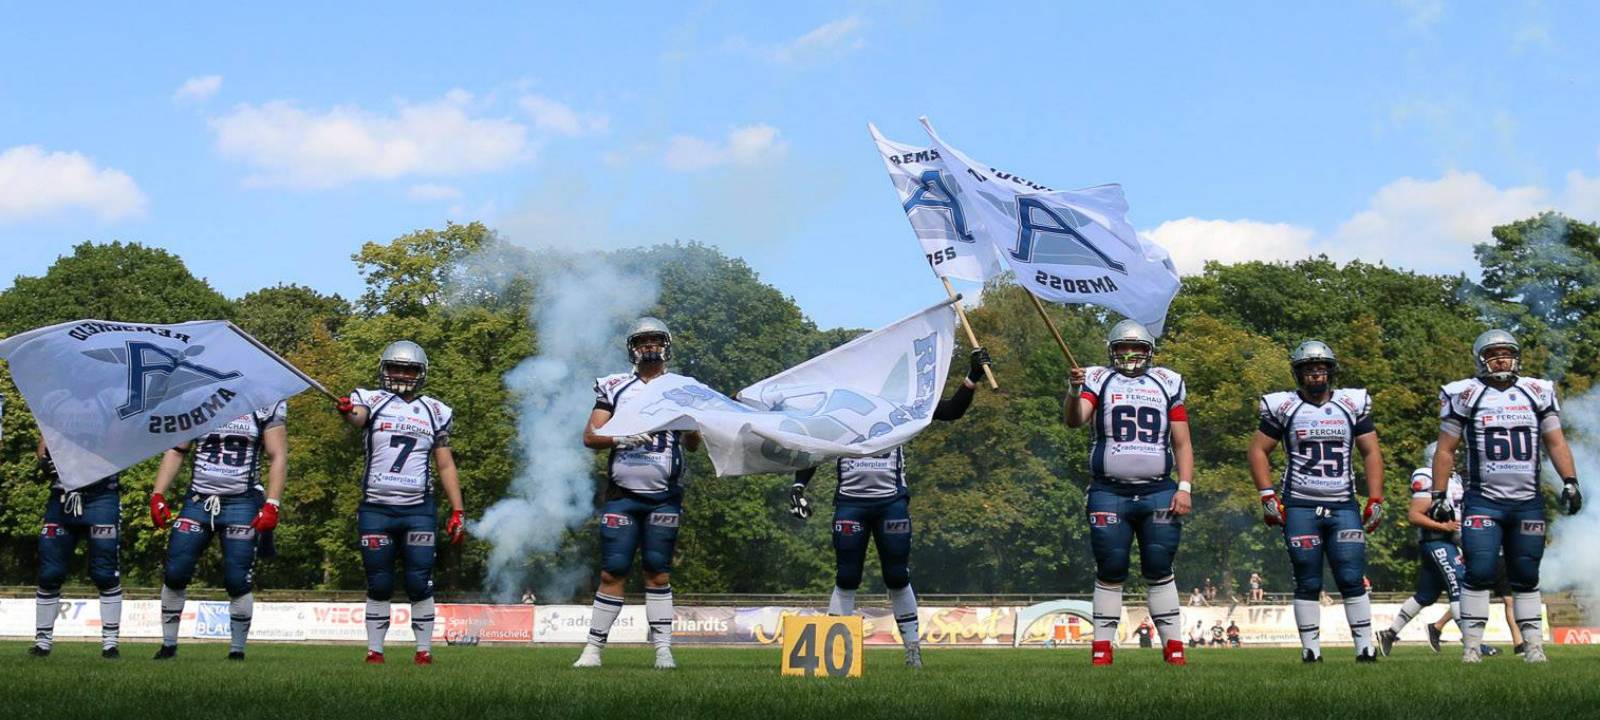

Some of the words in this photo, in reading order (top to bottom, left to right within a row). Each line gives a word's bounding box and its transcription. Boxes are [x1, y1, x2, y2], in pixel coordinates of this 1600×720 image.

[1111, 404, 1162, 444] 69
[1310, 428, 1346, 436] FERCHAU
[200, 432, 250, 467] 49
[1484, 426, 1533, 462] 60
[389, 434, 418, 474] 7
[1298, 439, 1345, 478] 25
[652, 514, 678, 525] VFT
[1523, 521, 1544, 532] VFT
[409, 533, 434, 544] VFT
[1340, 531, 1363, 541] VFT
[1247, 607, 1286, 623] VFT
[672, 616, 729, 632] rhardts
[788, 622, 853, 677] 40
